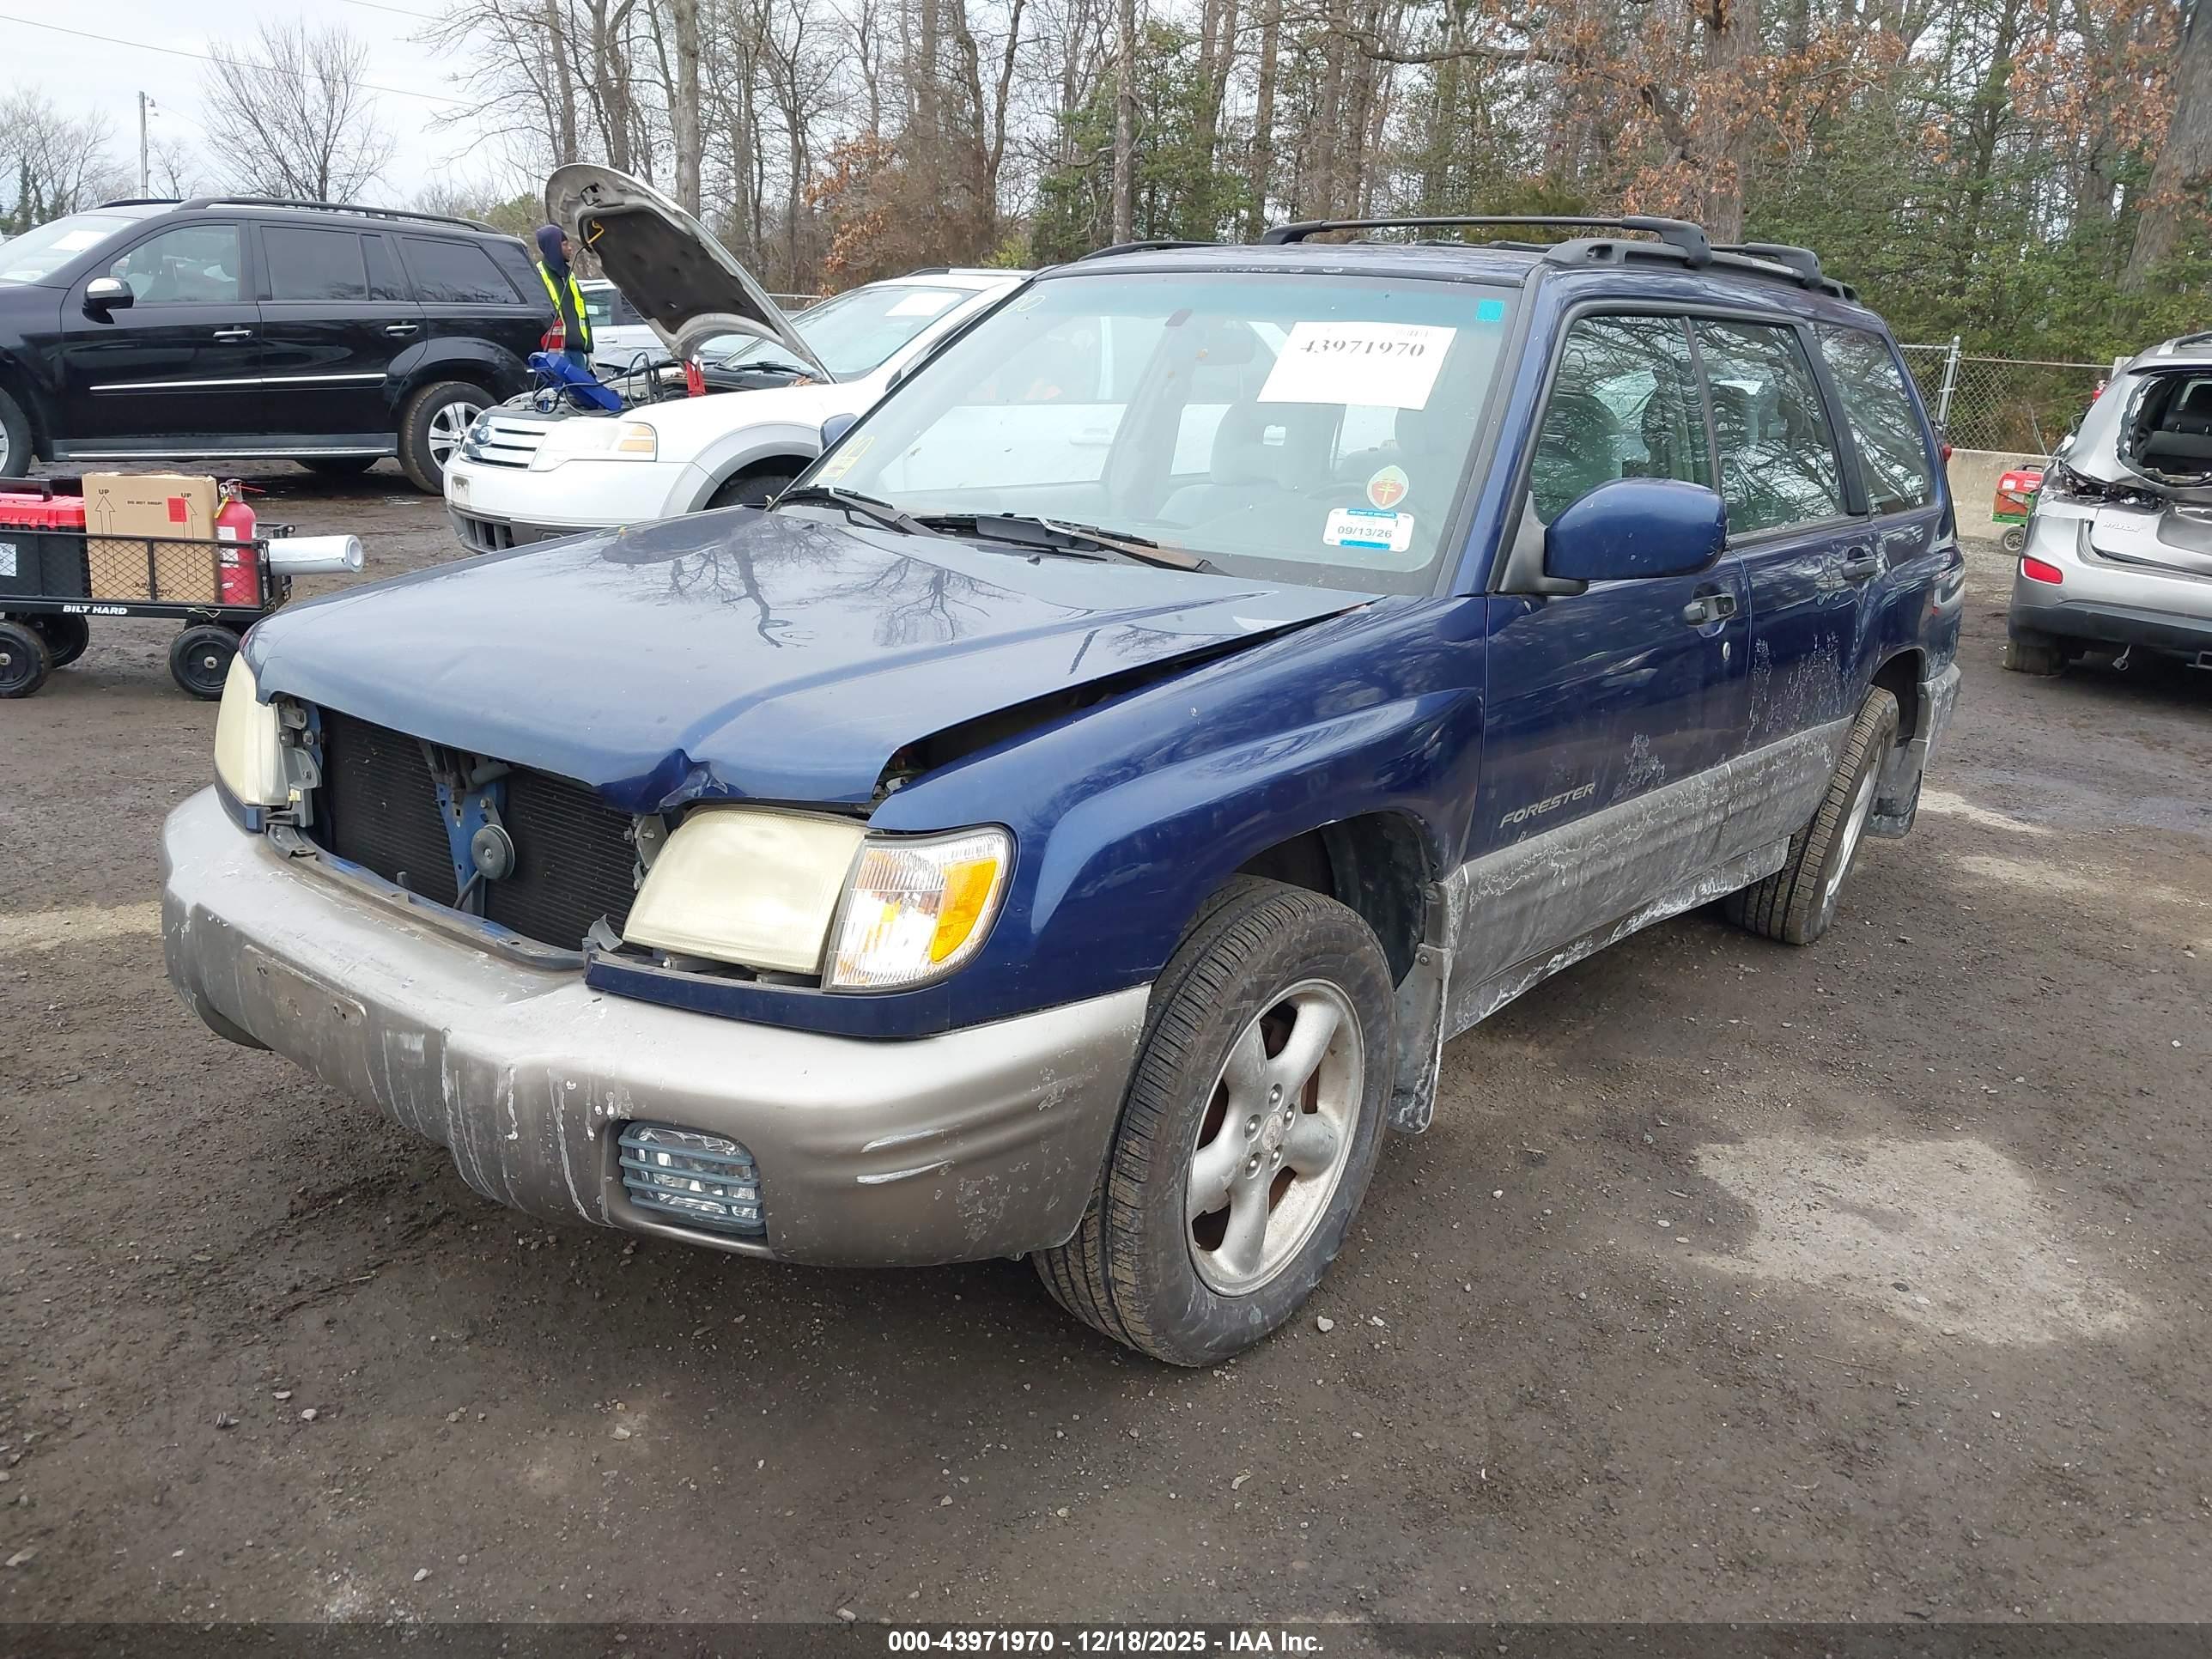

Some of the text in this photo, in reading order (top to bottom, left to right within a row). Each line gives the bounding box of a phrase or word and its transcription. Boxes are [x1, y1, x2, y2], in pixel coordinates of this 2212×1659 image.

[1300, 339, 1425, 356] 43971970
[1338, 526, 1393, 538] 09/13/26
[63, 605, 128, 615] BILT HARD
[1498, 781, 1596, 829] FORESTER
